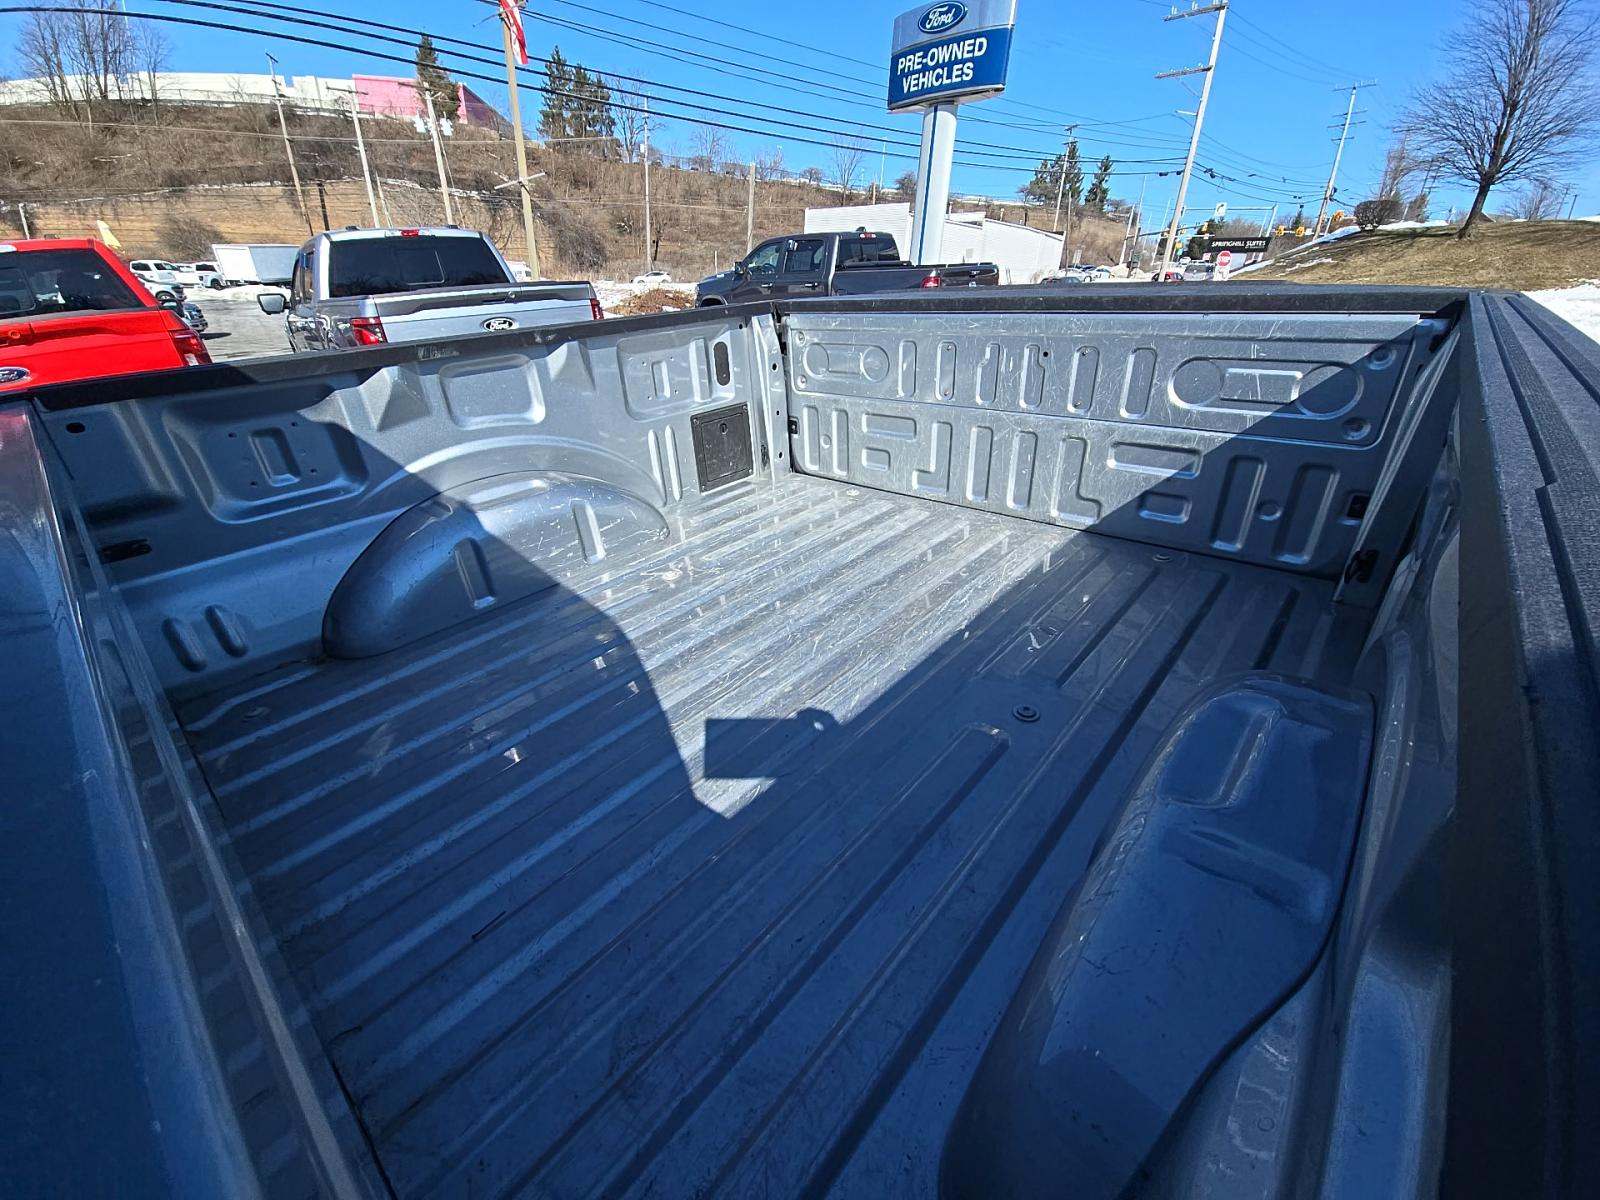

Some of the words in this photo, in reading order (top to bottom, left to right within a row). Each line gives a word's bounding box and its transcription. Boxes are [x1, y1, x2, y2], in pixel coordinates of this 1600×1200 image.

[925, 6, 955, 29] Ford
[897, 37, 988, 75] PRE-OWNED
[903, 62, 974, 94] VEHICLES
